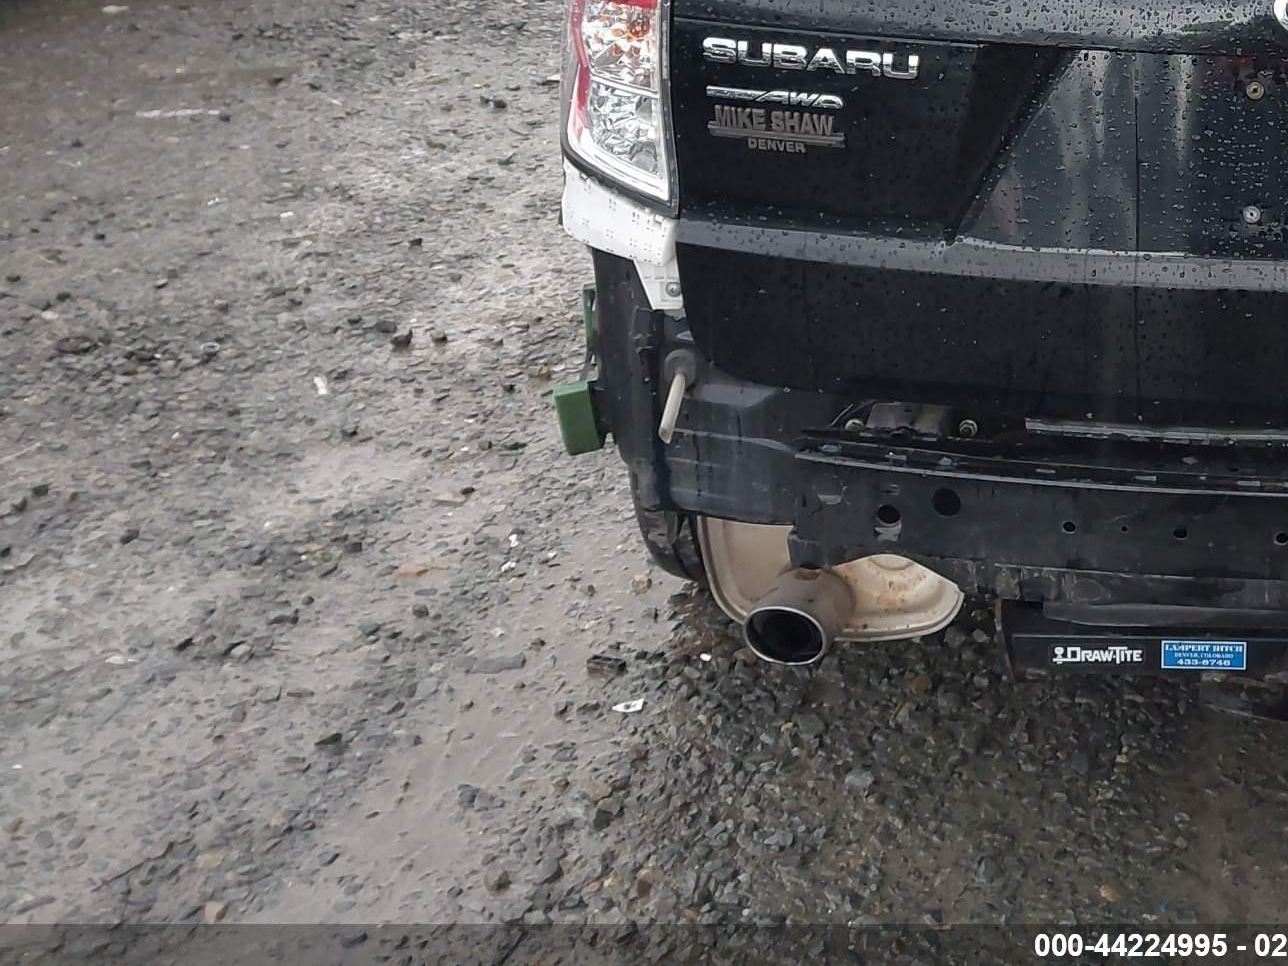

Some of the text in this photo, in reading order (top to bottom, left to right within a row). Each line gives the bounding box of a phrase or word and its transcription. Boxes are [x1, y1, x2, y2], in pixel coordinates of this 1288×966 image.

[702, 36, 920, 80] SUBARU
[755, 89, 846, 110] AWD
[713, 104, 836, 137] MIKE SHAW
[747, 138, 807, 155] DENVER
[1213, 645, 1243, 653] HITCH
